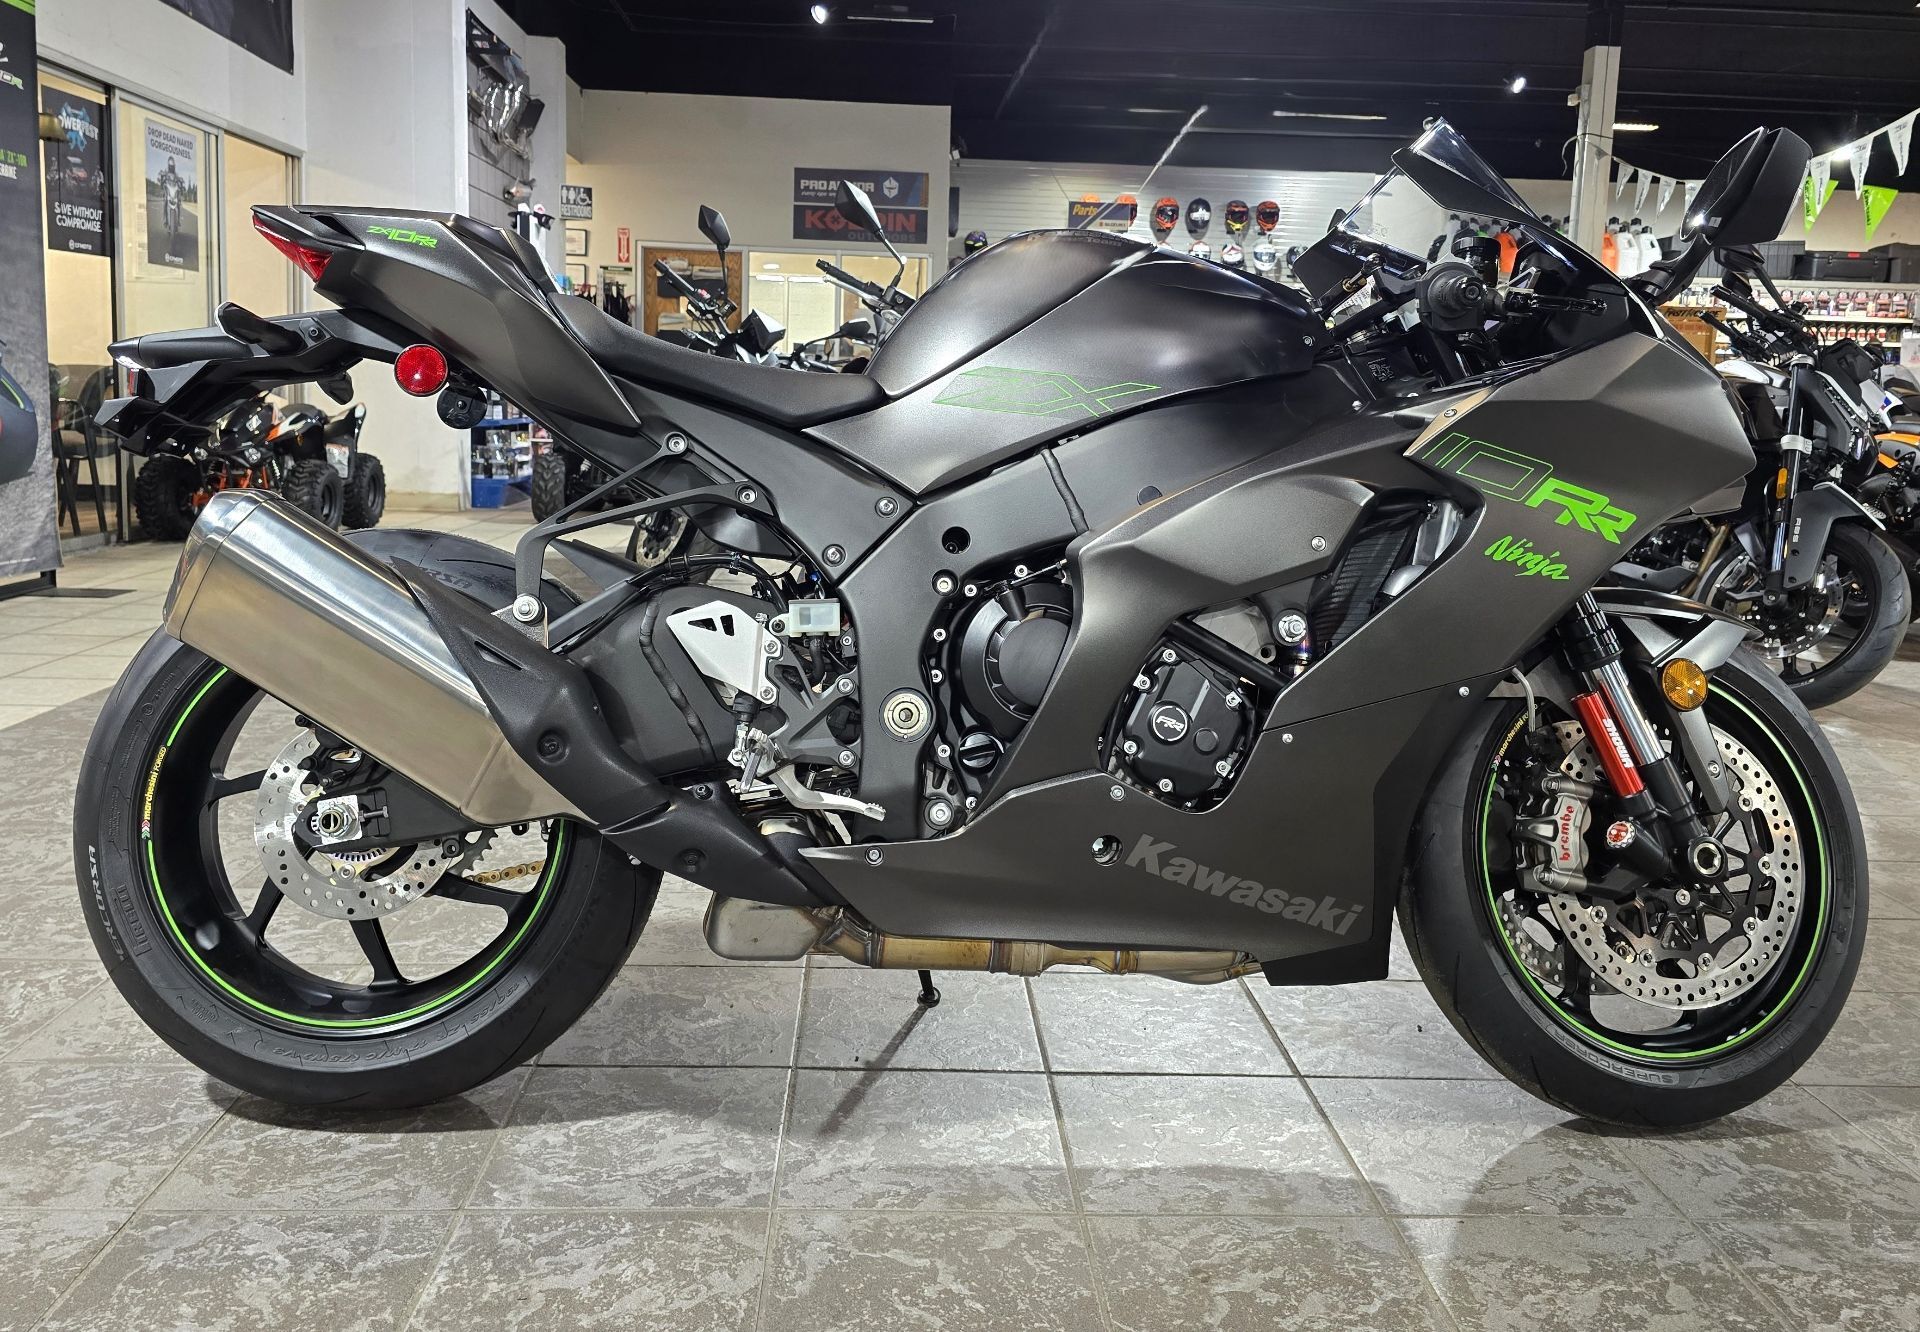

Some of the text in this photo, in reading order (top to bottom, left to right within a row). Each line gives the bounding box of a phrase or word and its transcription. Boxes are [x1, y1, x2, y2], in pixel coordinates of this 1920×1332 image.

[147, 126, 194, 150] DROP DEAD NAKED
[72, 204, 103, 221] WITHOUT
[561, 204, 592, 218] RESTROOMS
[1072, 204, 1098, 217] Parts
[1484, 535, 1570, 580] Ninja
[1602, 718, 1634, 769] SHOWA
[143, 770, 159, 820] marchesini
[1559, 804, 1576, 863] brembo
[1125, 833, 1365, 936] Kawasaki
